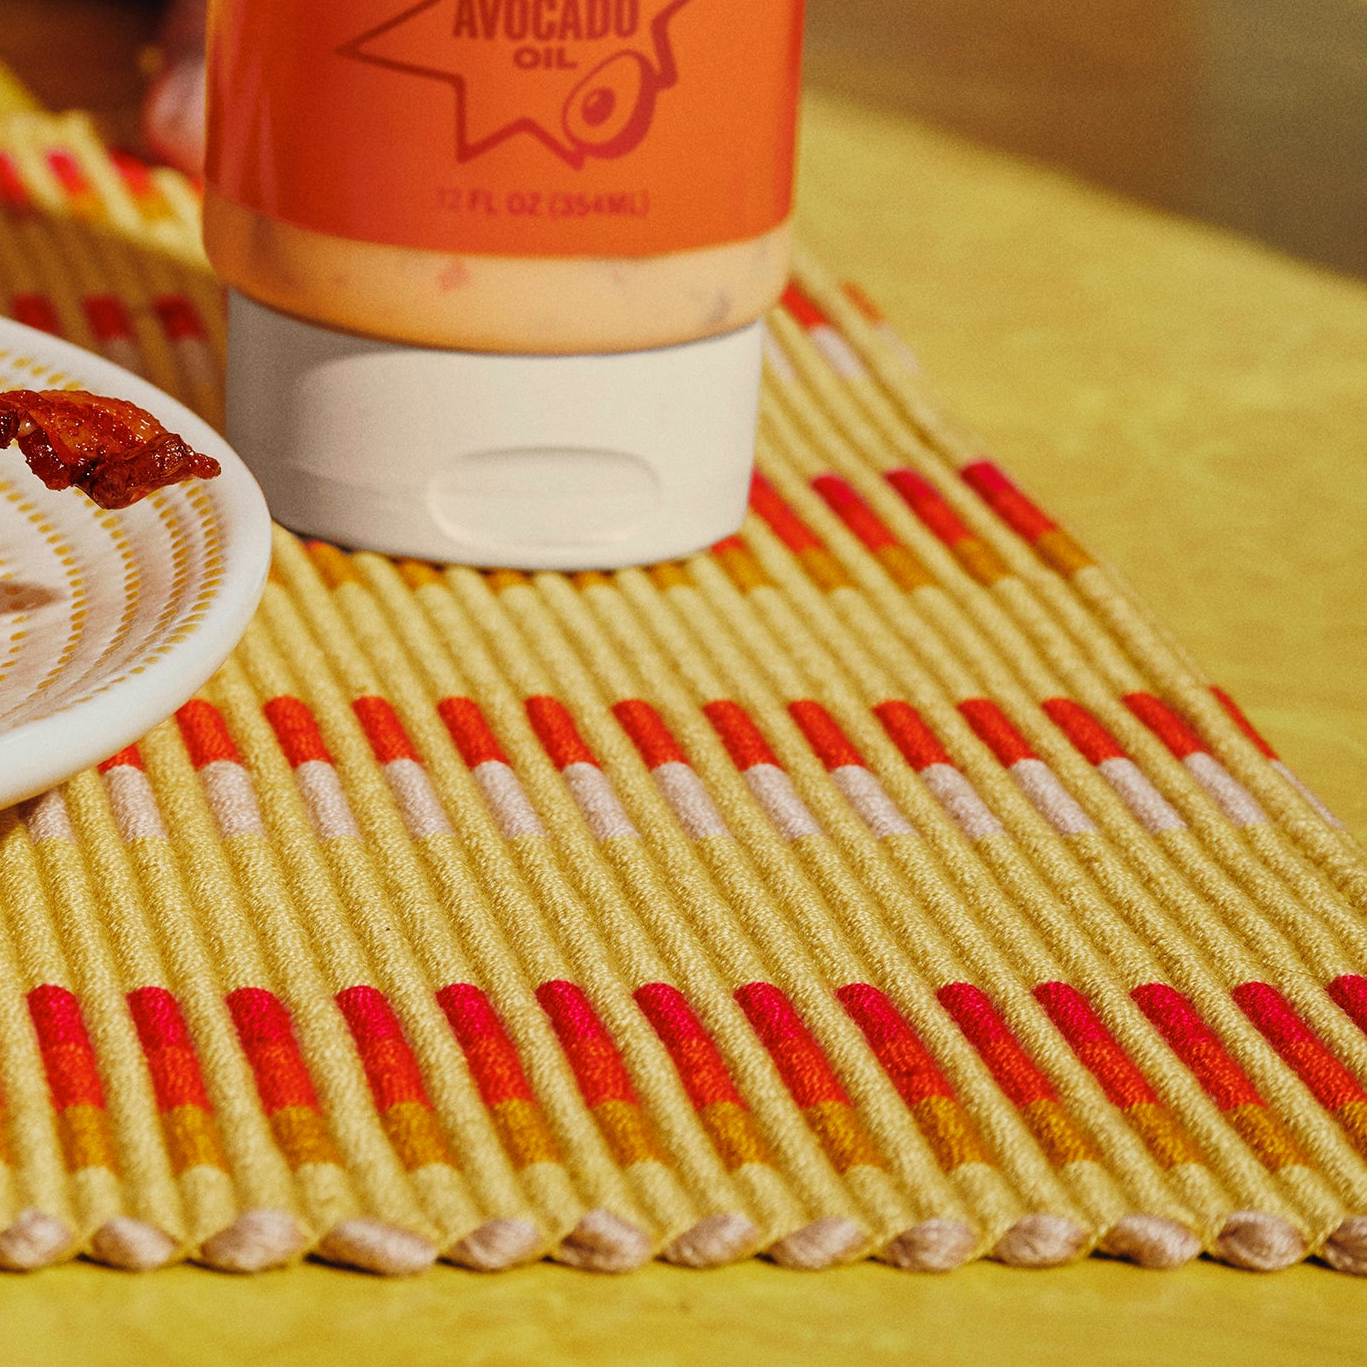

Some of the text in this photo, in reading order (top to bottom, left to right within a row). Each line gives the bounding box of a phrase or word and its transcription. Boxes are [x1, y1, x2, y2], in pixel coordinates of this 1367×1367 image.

[513, 47, 578, 70] OIL
[469, 190, 499, 217] FL
[506, 191, 543, 217] OZ
[548, 189, 651, 219] (354ML)
